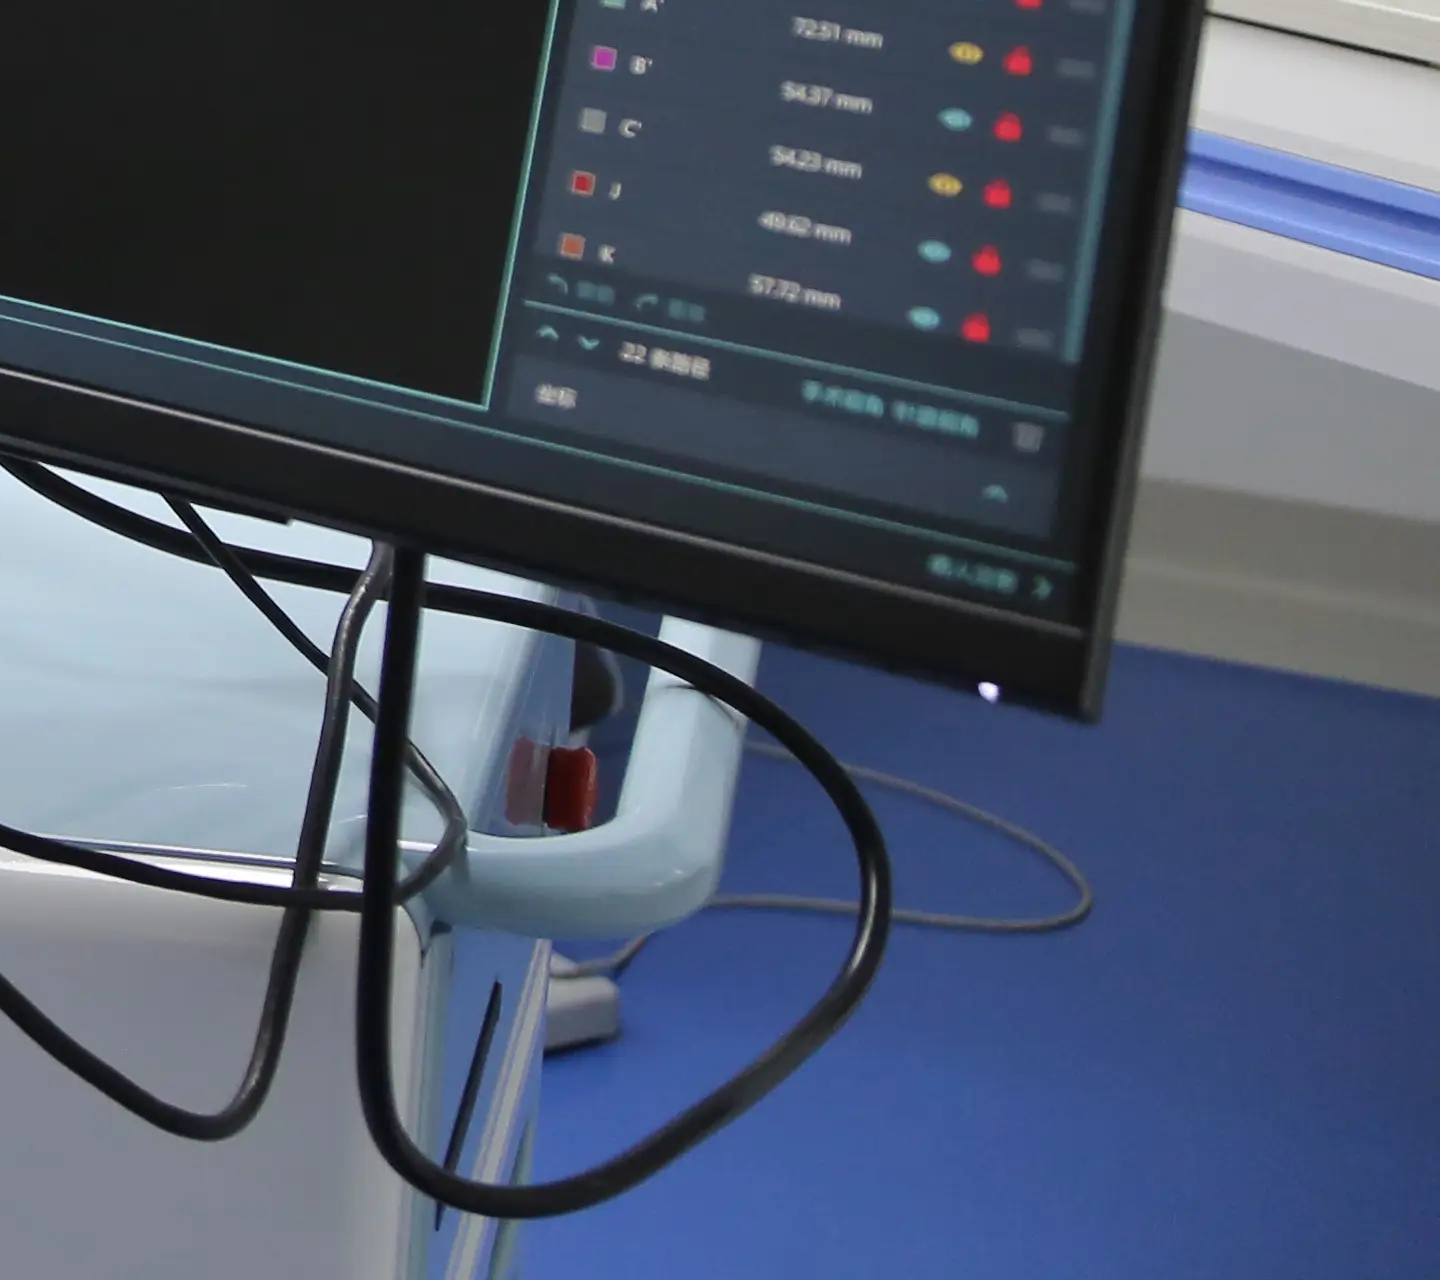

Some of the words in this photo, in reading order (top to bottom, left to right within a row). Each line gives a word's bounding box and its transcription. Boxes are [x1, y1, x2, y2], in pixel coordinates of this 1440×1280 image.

[844, 26, 883, 50] mm
[835, 92, 873, 115] mm
[823, 154, 863, 179] mm
[814, 221, 852, 246] mm
[802, 287, 842, 311] mm
